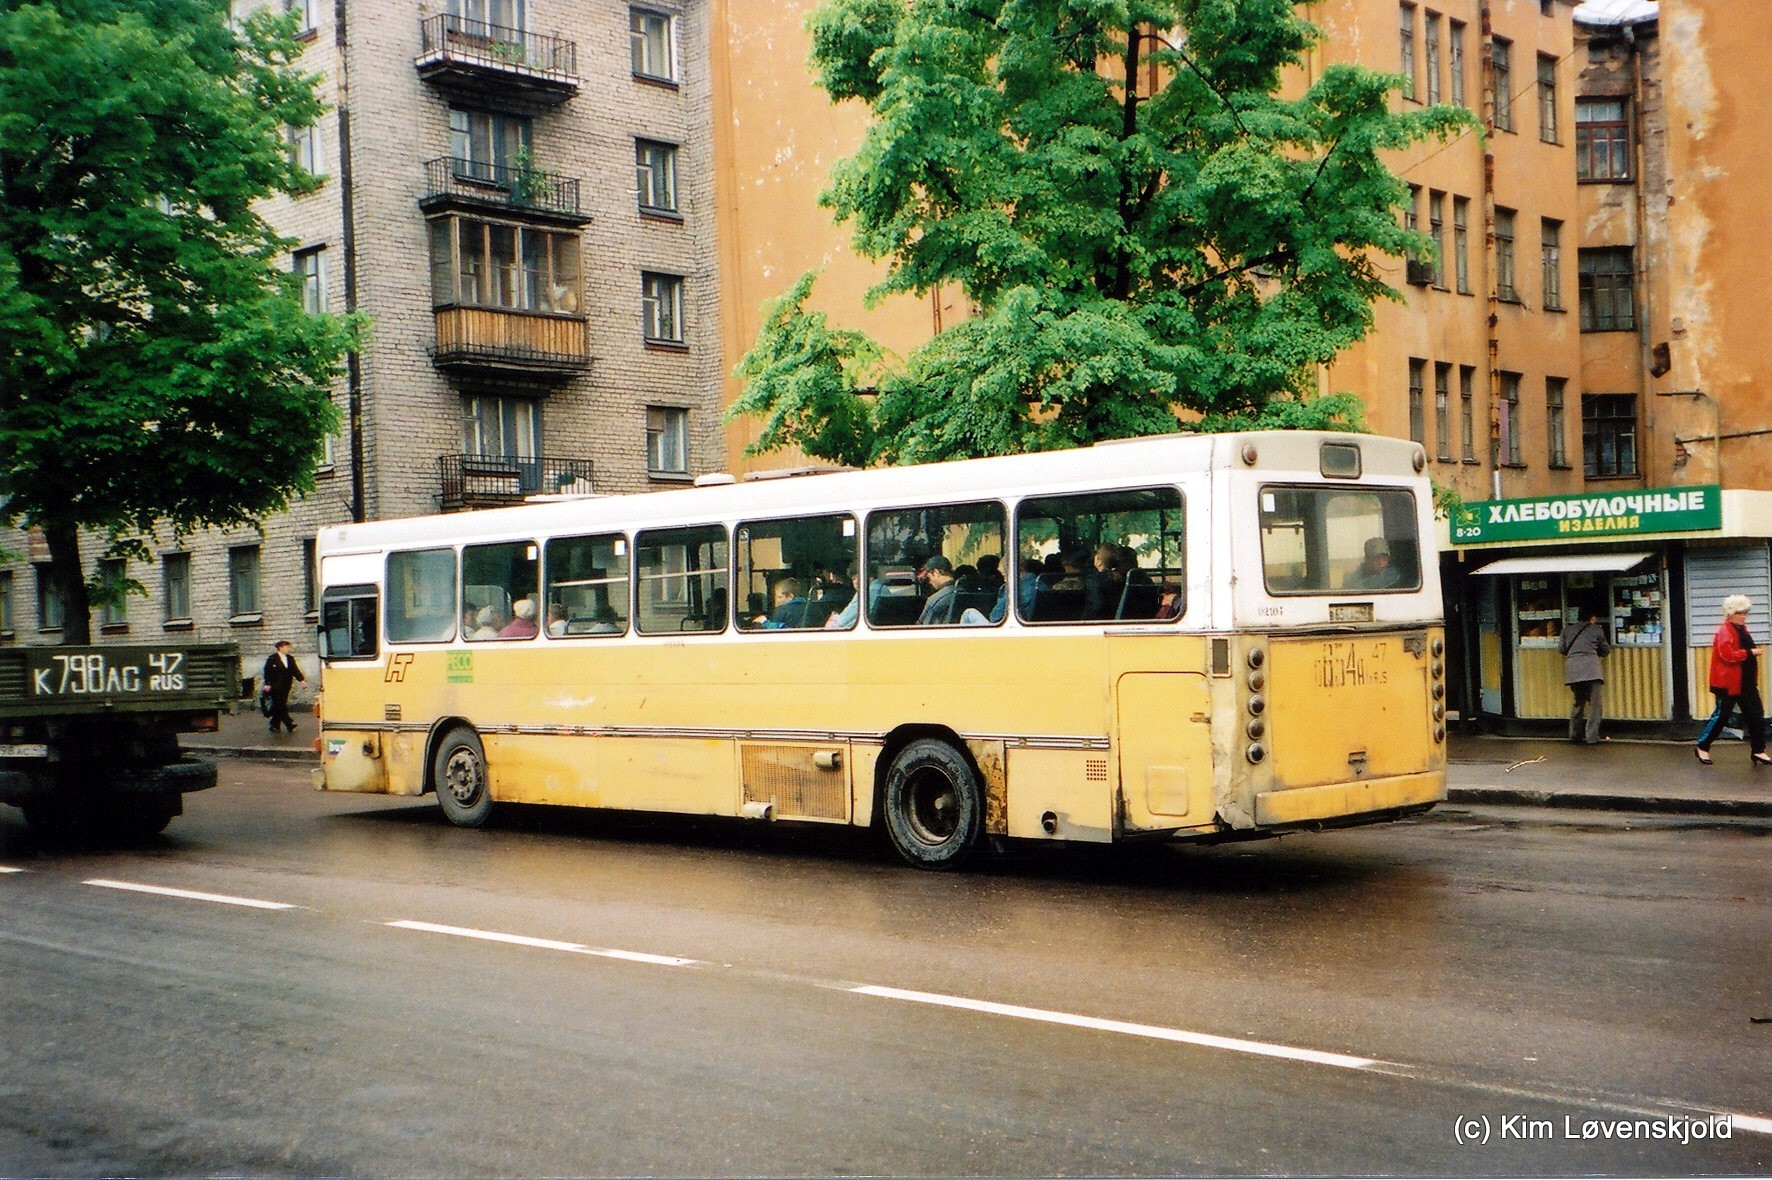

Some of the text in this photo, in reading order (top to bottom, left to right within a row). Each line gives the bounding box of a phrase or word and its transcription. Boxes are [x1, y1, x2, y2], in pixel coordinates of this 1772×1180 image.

[1488, 491, 1705, 524] ХЛЕБОБУЛОЧНЫЕ
[1558, 515, 1640, 533] ИЗДЕЛИЯ
[149, 653, 183, 674] 47
[150, 674, 185, 691] RUS
